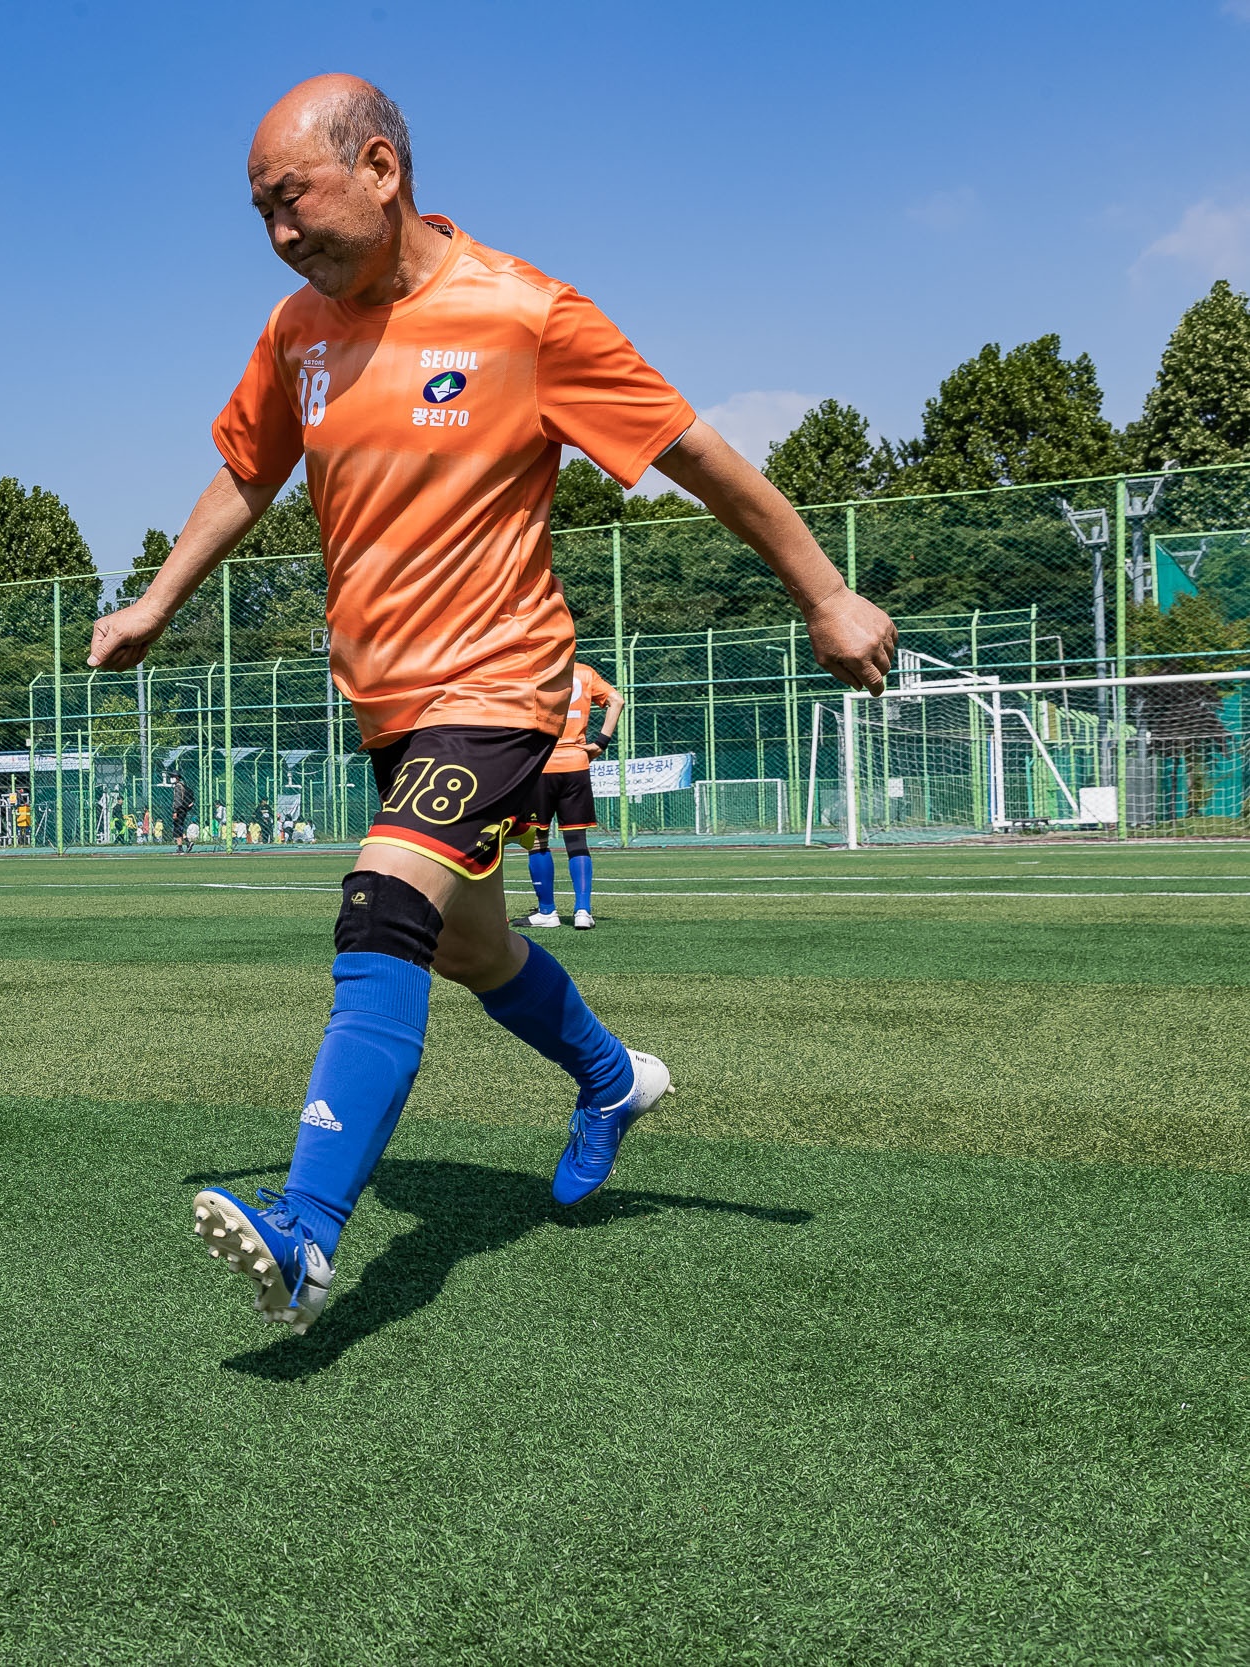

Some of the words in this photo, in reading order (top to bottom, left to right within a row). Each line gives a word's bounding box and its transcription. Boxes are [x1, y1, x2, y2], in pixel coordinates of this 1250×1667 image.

[420, 349, 479, 371] SEOUL
[299, 368, 331, 427] 18
[411, 407, 470, 427] 광진70
[627, 758, 674, 775] 개보수공사
[382, 757, 478, 825] 18
